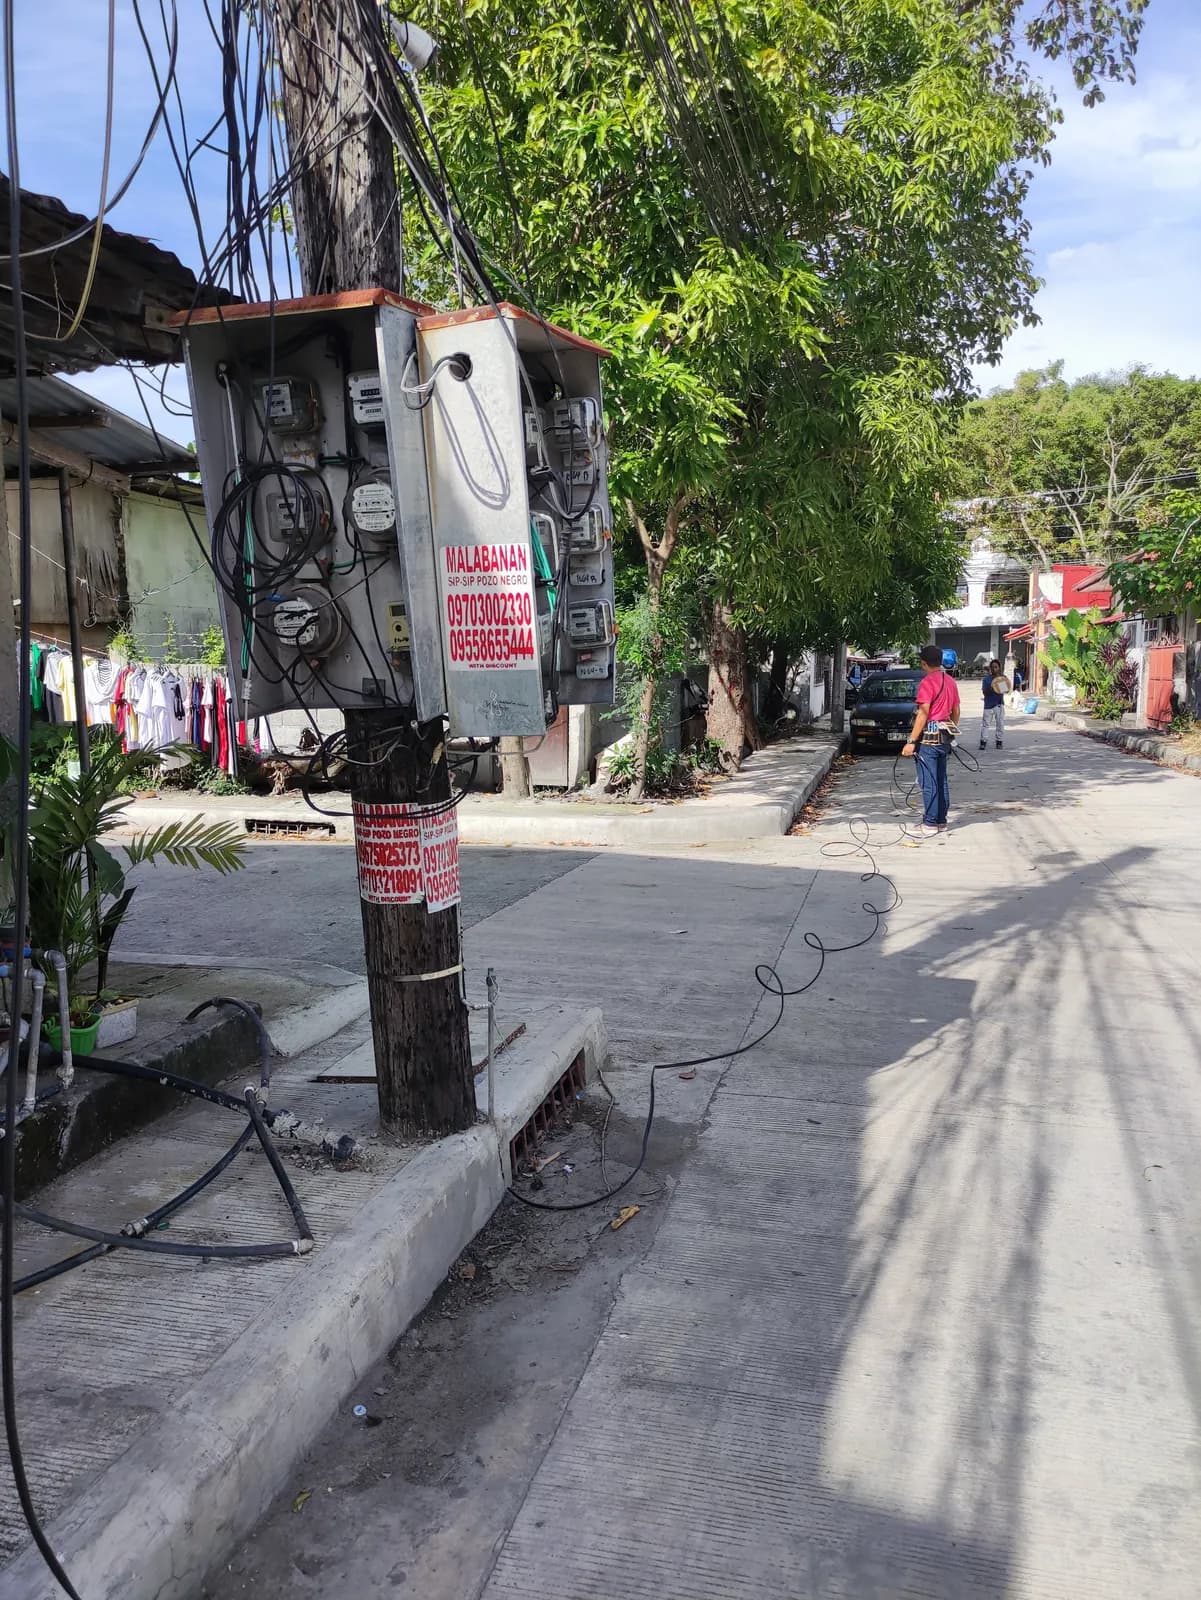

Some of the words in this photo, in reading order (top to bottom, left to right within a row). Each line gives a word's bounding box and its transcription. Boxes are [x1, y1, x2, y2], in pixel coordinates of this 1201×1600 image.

[446, 545, 527, 573] MALABANAN
[448, 576, 475, 587] SIP-SIP
[477, 575, 498, 586] POZO
[500, 575, 528, 586] NEGRO
[447, 592, 532, 627] 09703002330
[450, 628, 534, 661] 09558655444
[373, 830, 392, 839] POZO
[393, 829, 419, 839] NEGRO
